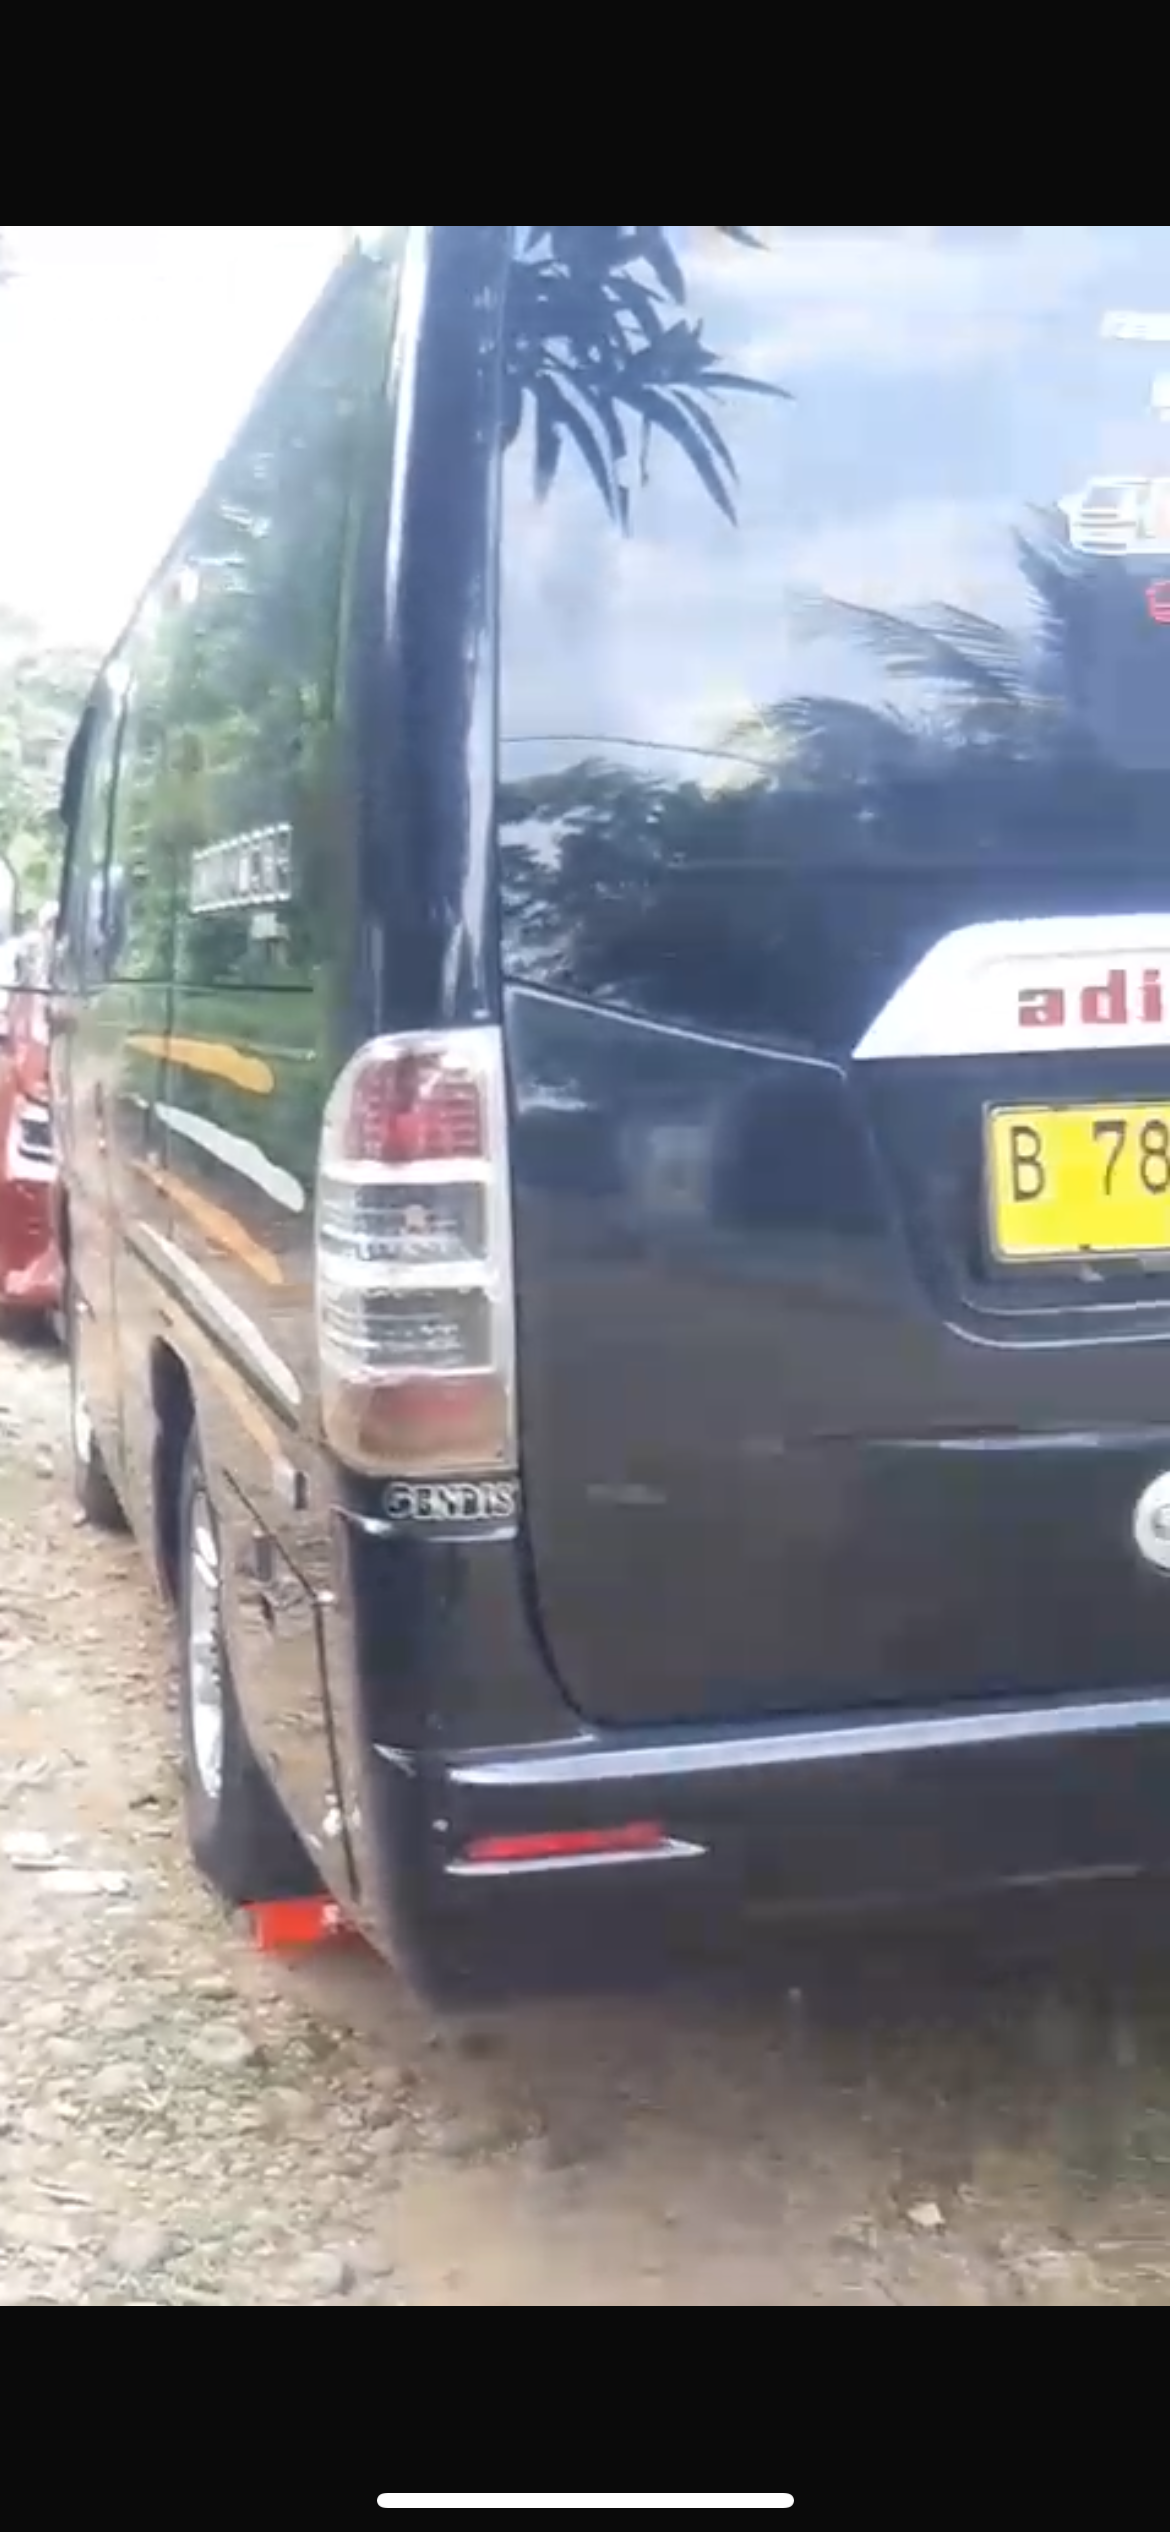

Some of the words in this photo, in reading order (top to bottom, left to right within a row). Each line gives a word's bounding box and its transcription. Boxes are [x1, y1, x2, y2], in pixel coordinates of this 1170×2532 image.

[1010, 1124, 1046, 1202] B
[1093, 1118, 1170, 1195] 78
[384, 1481, 518, 1520] GENDIS
